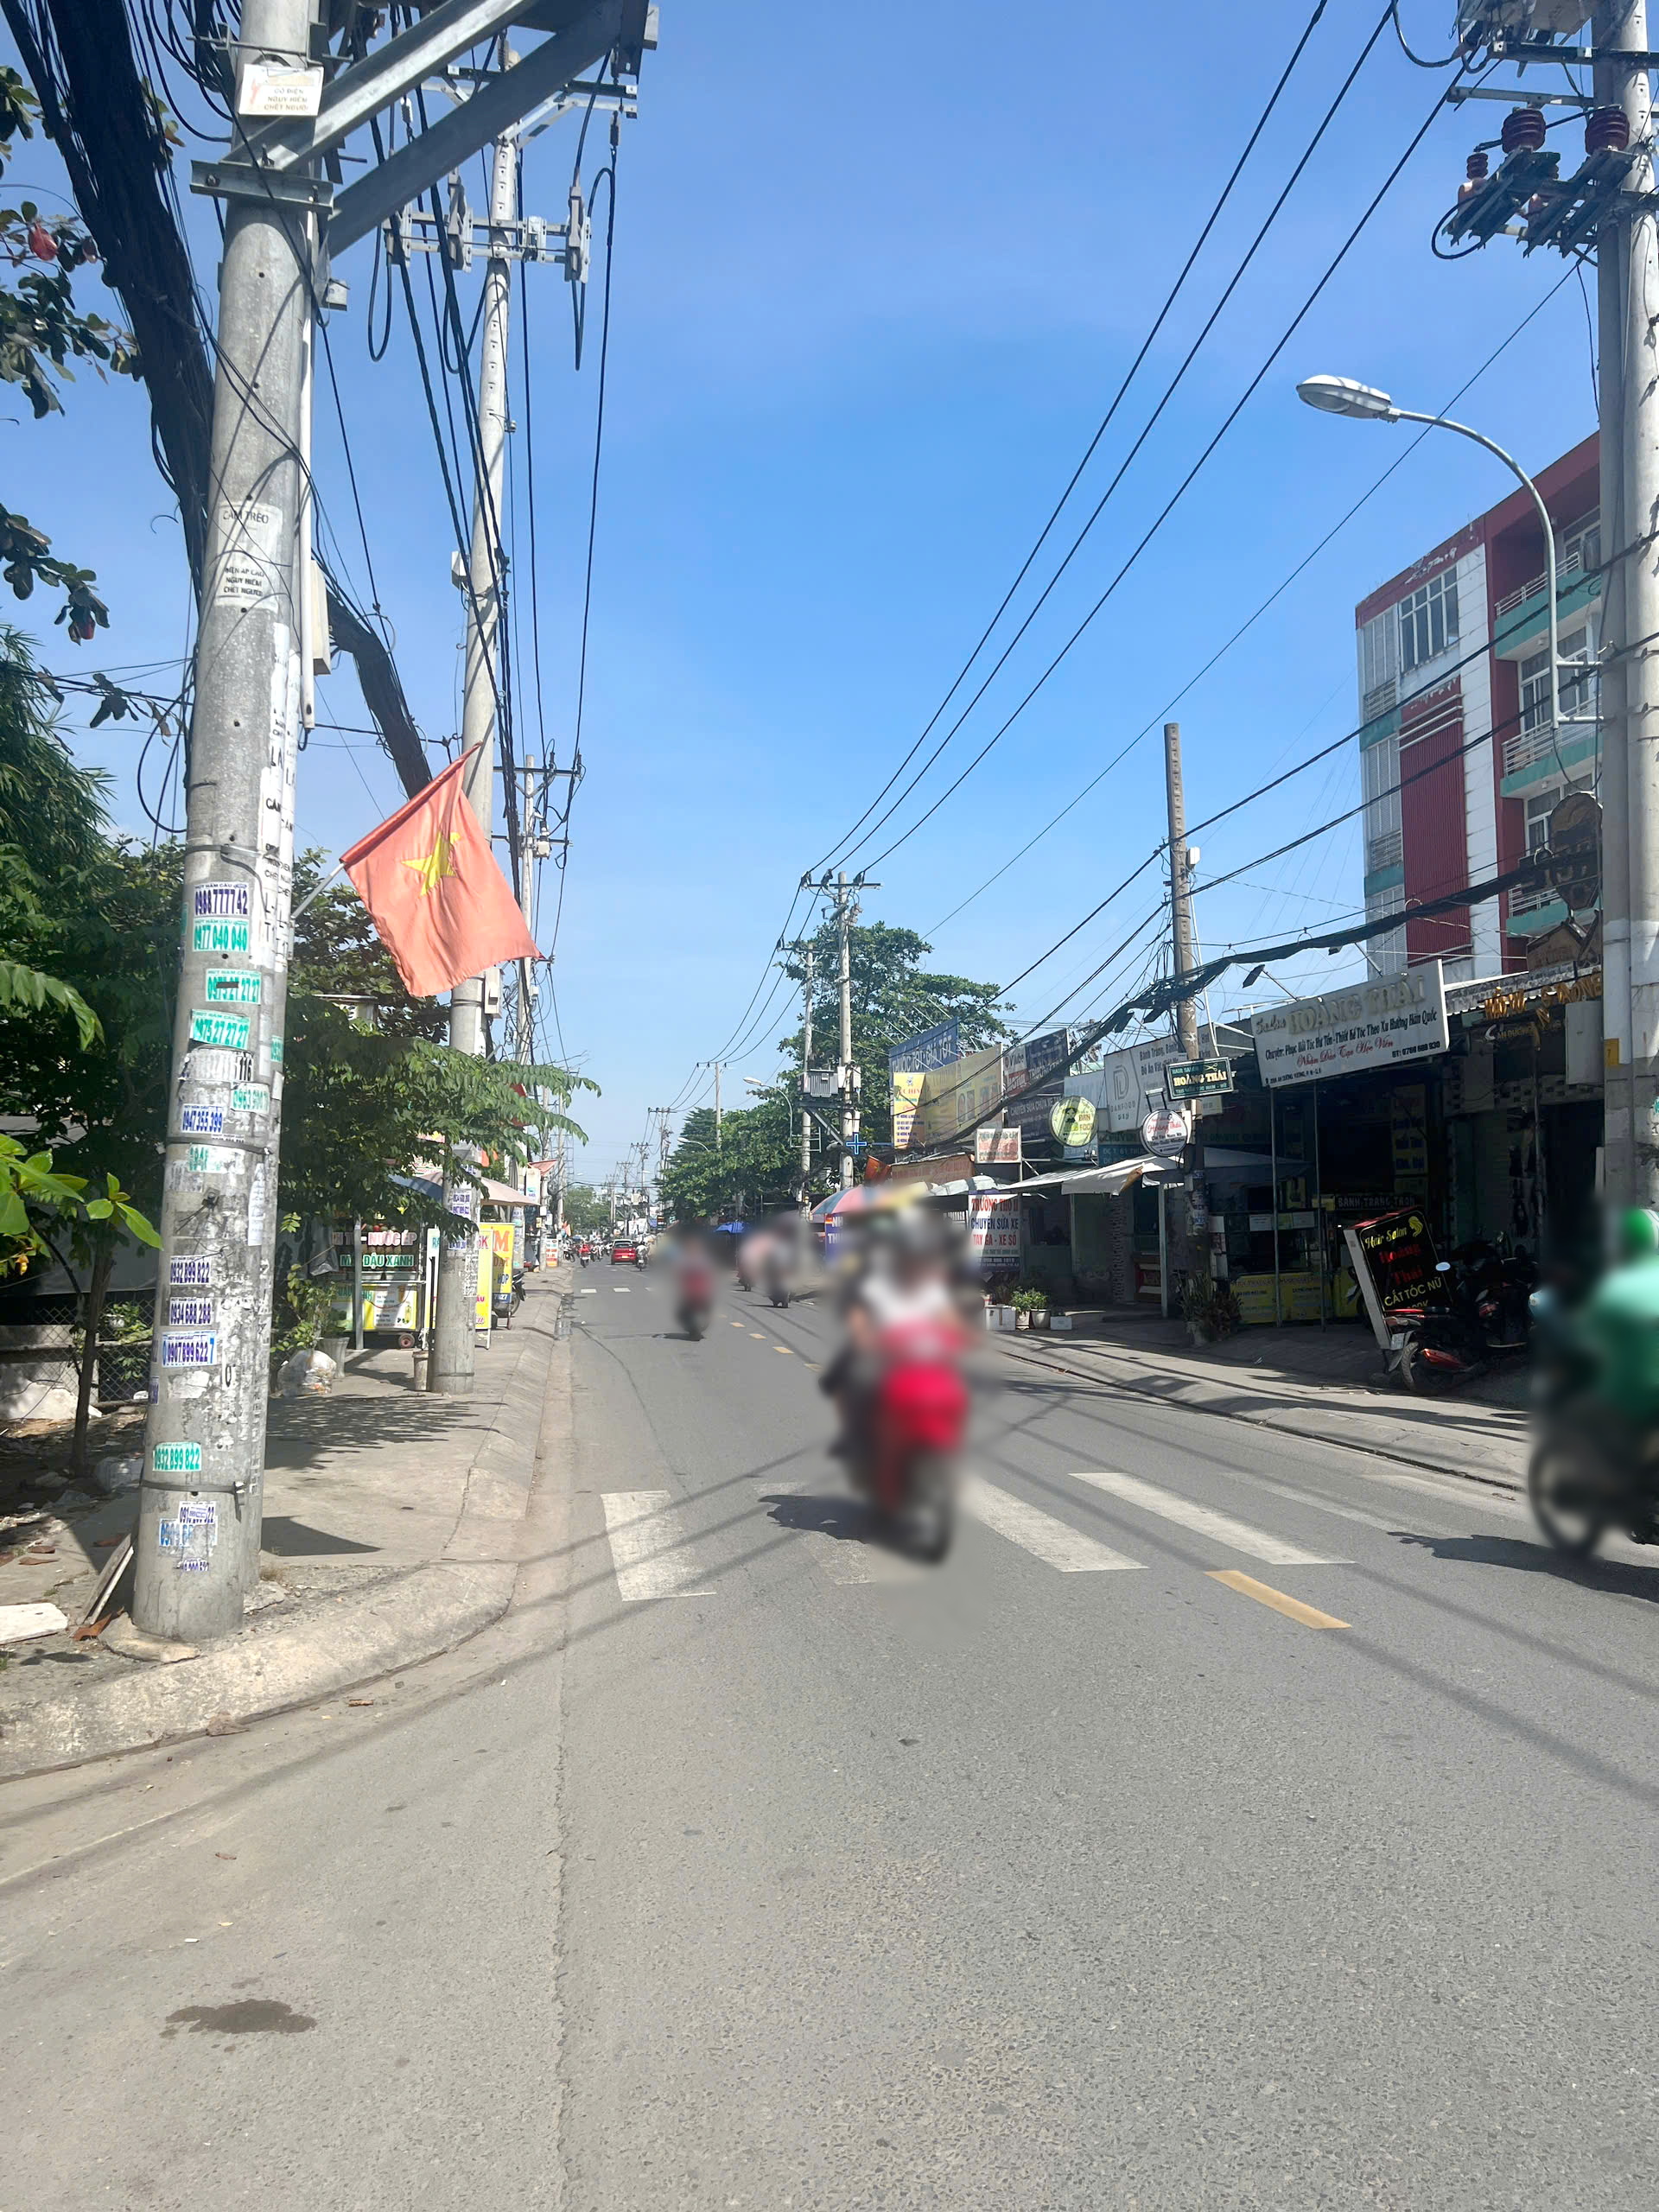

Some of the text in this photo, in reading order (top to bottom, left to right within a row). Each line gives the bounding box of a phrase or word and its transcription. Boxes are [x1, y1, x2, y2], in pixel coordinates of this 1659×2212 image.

[1011, 1218, 1018, 1230] XE
[973, 1235, 982, 1246] TAY
[985, 1235, 993, 1246] GA
[999, 1235, 1007, 1246] XE
[1365, 1226, 1408, 1249] Hair Salon
[363, 1251, 385, 1269] ĐẬU
[385, 1254, 415, 1268] XANH
[1384, 1288, 1404, 1306] CẮT
[1405, 1282, 1426, 1300] TÓC
